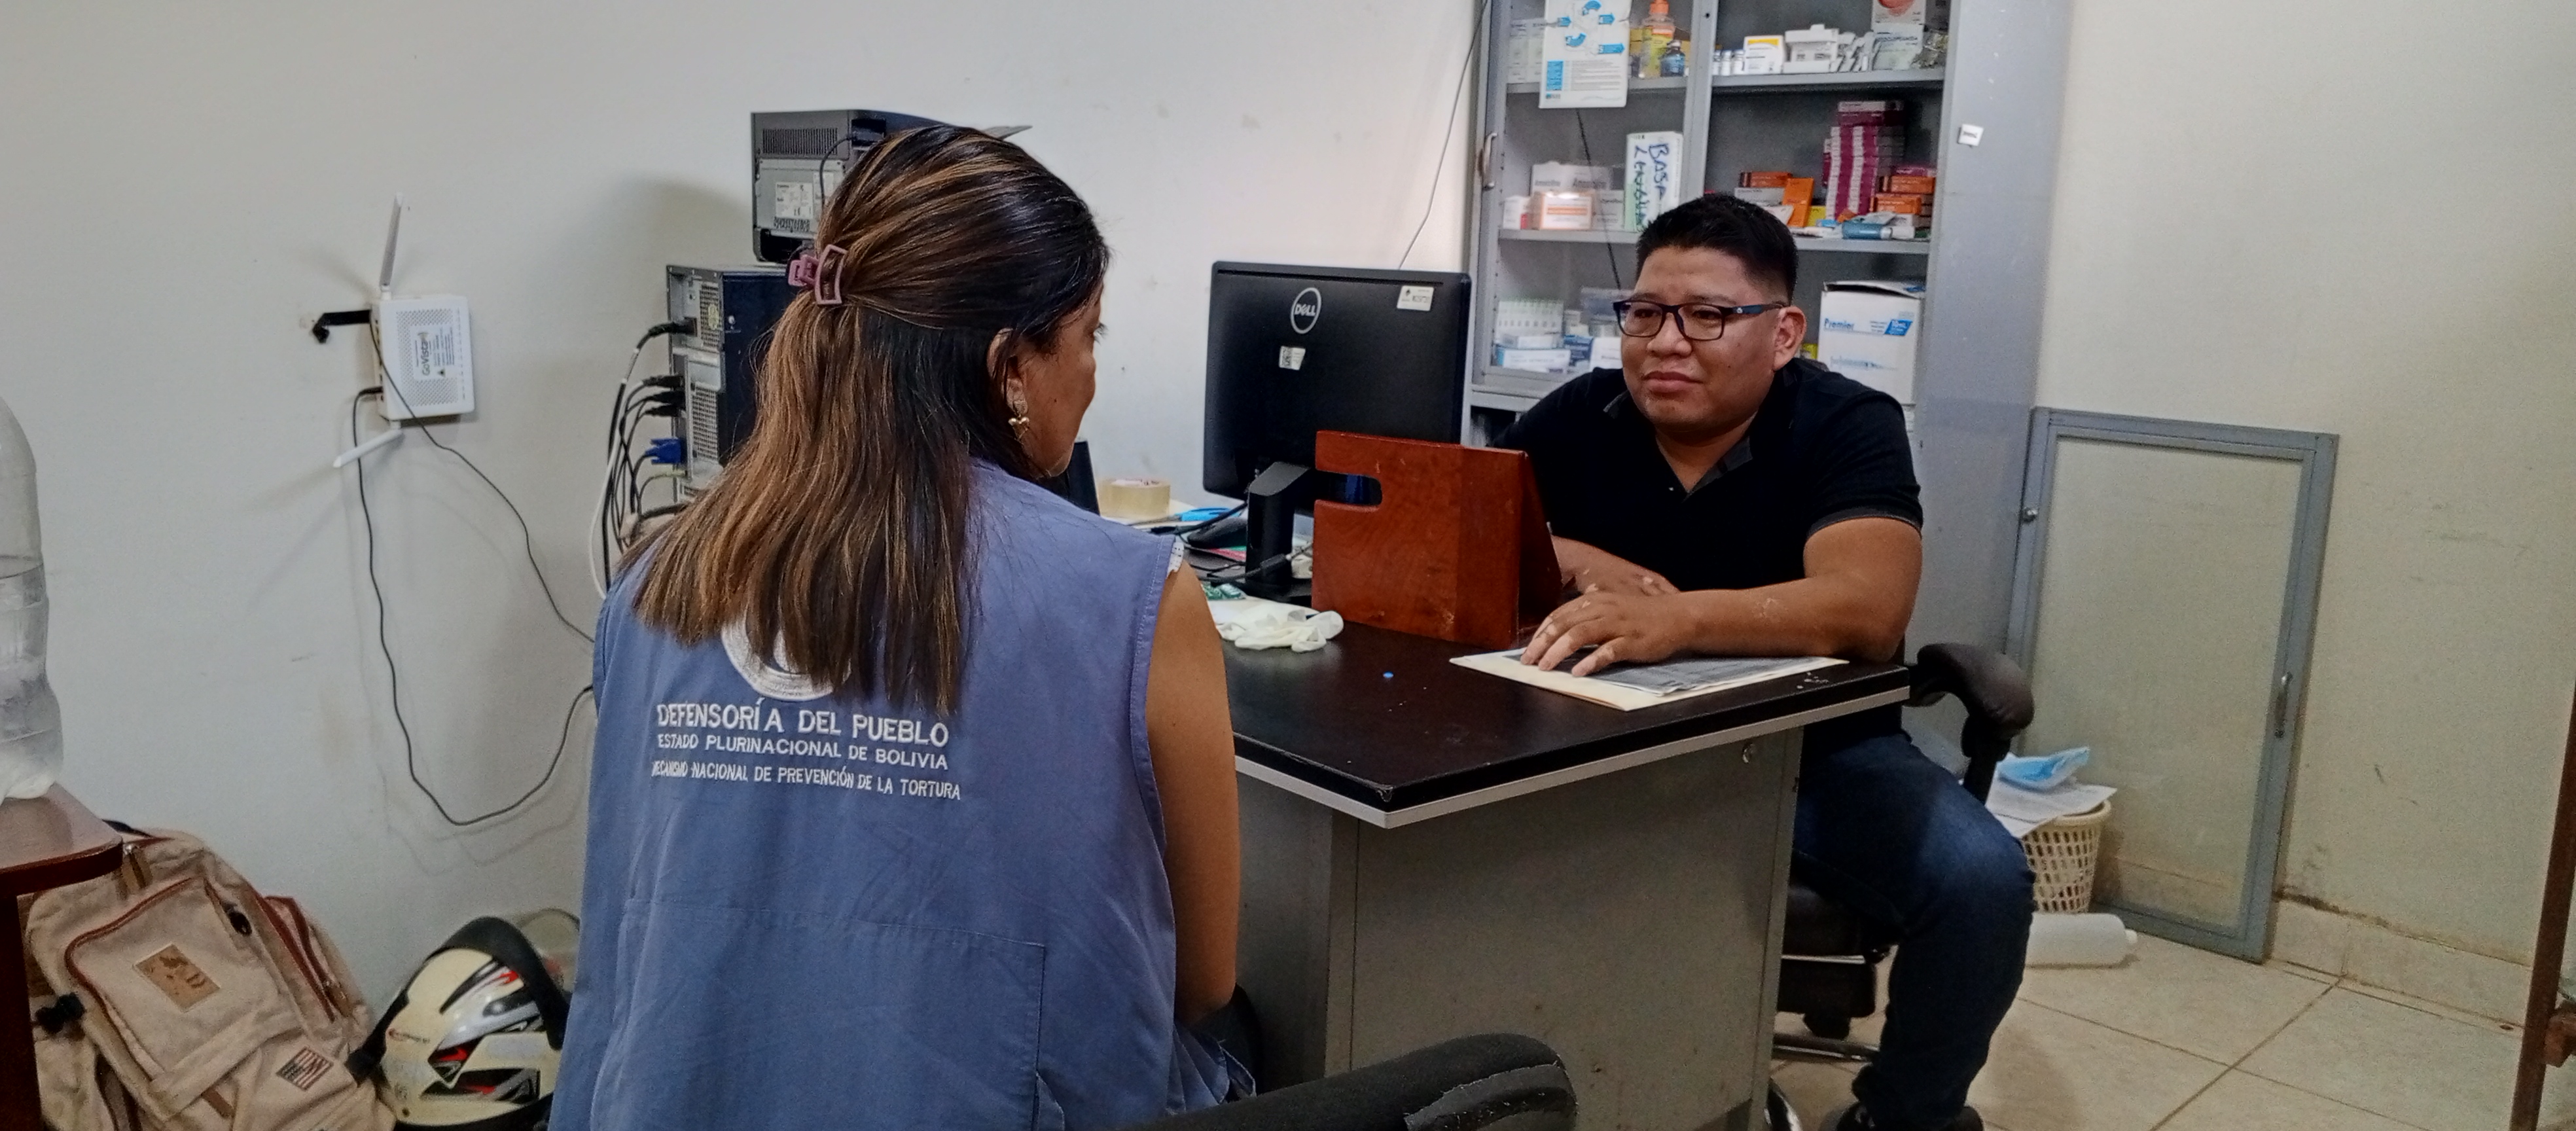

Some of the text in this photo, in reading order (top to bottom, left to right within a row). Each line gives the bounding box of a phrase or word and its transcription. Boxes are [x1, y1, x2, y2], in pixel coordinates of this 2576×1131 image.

[1295, 304, 1315, 316] DELL
[1824, 318, 1854, 331] Premier
[657, 697, 949, 747] DEFENSORÍA DEL PUEBLO
[658, 734, 948, 770] ESTADO PLURINACIONAL DE BOLIVIA
[692, 761, 748, 782] NACIONAL
[754, 766, 772, 782] DE
[778, 765, 854, 789] PREVENCIÓN
[857, 774, 873, 791] DE
[877, 776, 893, 795] LA
[900, 778, 961, 800] TORTURA
